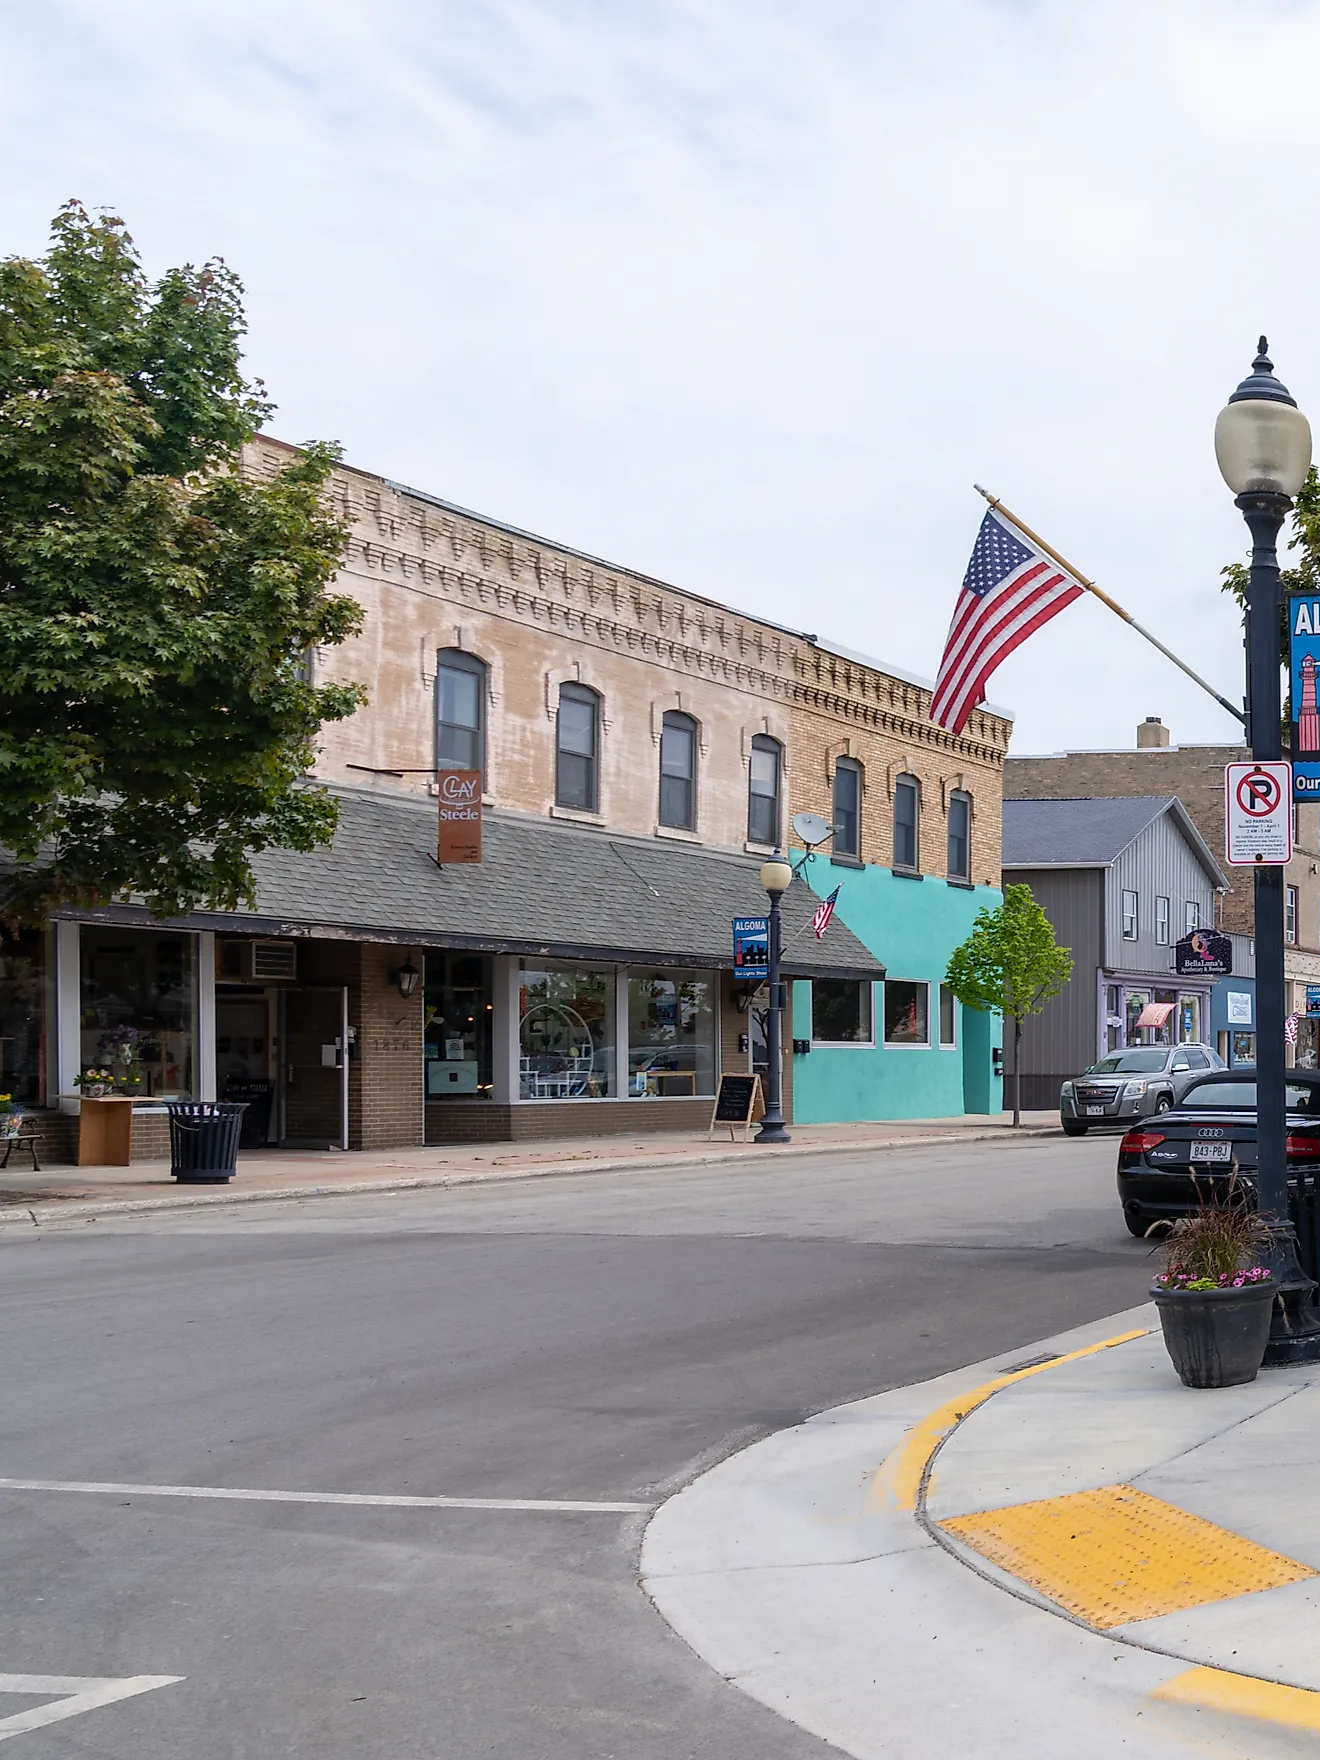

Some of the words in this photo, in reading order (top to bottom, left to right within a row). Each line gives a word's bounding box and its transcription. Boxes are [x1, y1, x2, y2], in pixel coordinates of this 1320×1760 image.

[443, 775, 477, 798] CLAY
[1296, 776, 1320, 791] Our
[440, 808, 479, 821] Steele
[736, 920, 766, 930] ALGOMA
[1194, 1146, 1228, 1157] 843-PBJ
